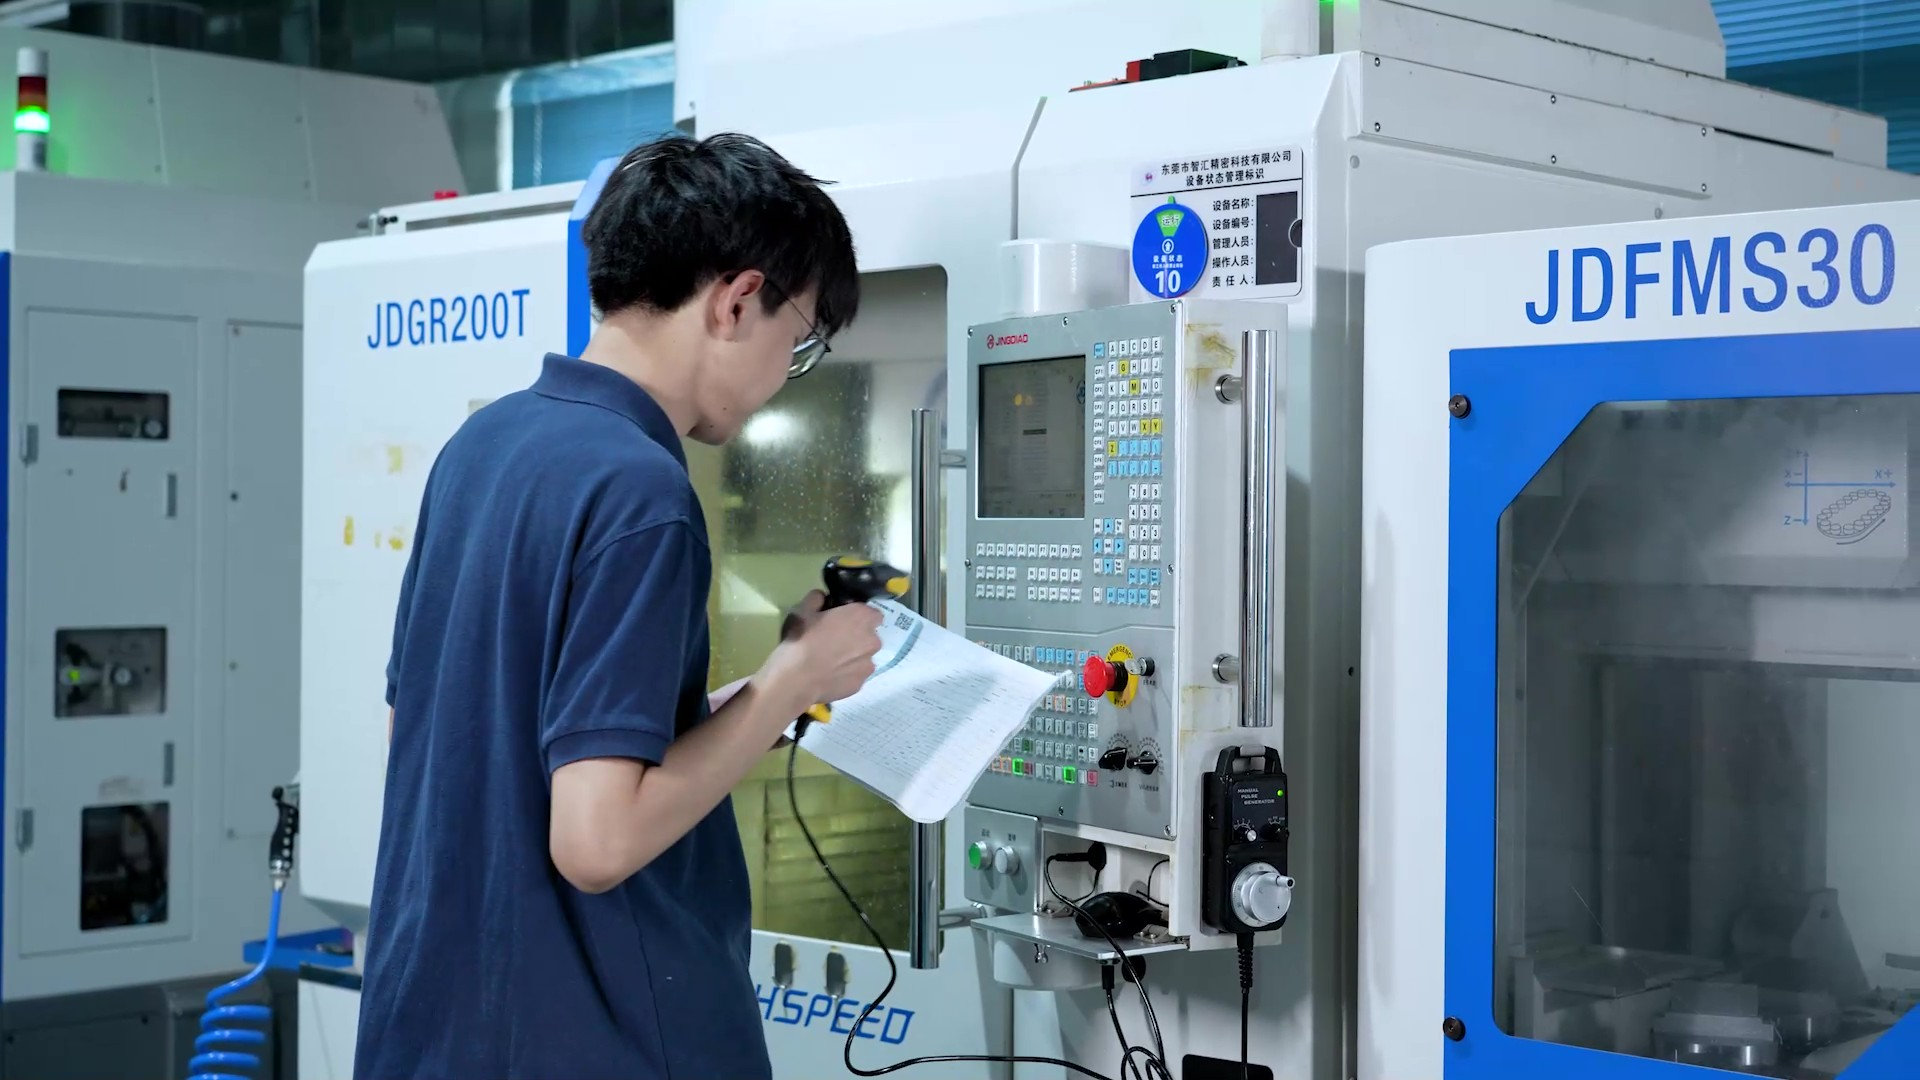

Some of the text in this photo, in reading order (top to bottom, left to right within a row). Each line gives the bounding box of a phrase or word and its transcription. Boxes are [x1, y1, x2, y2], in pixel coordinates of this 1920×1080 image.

[1161, 150, 1291, 176] 东莞市智汇精密科技有限公司
[1186, 168, 1264, 187] 设备状态管理标识
[1212, 198, 1254, 212] 设备名称：
[1212, 217, 1254, 230] 设备编号：
[1212, 236, 1254, 250] 管理人员：
[1212, 255, 1254, 269] 操作人员：
[1155, 270, 1181, 294] 10
[1525, 223, 1895, 325] JDFMS30
[367, 289, 530, 349] JDGR200T
[996, 334, 1028, 346] JINGDIAO
